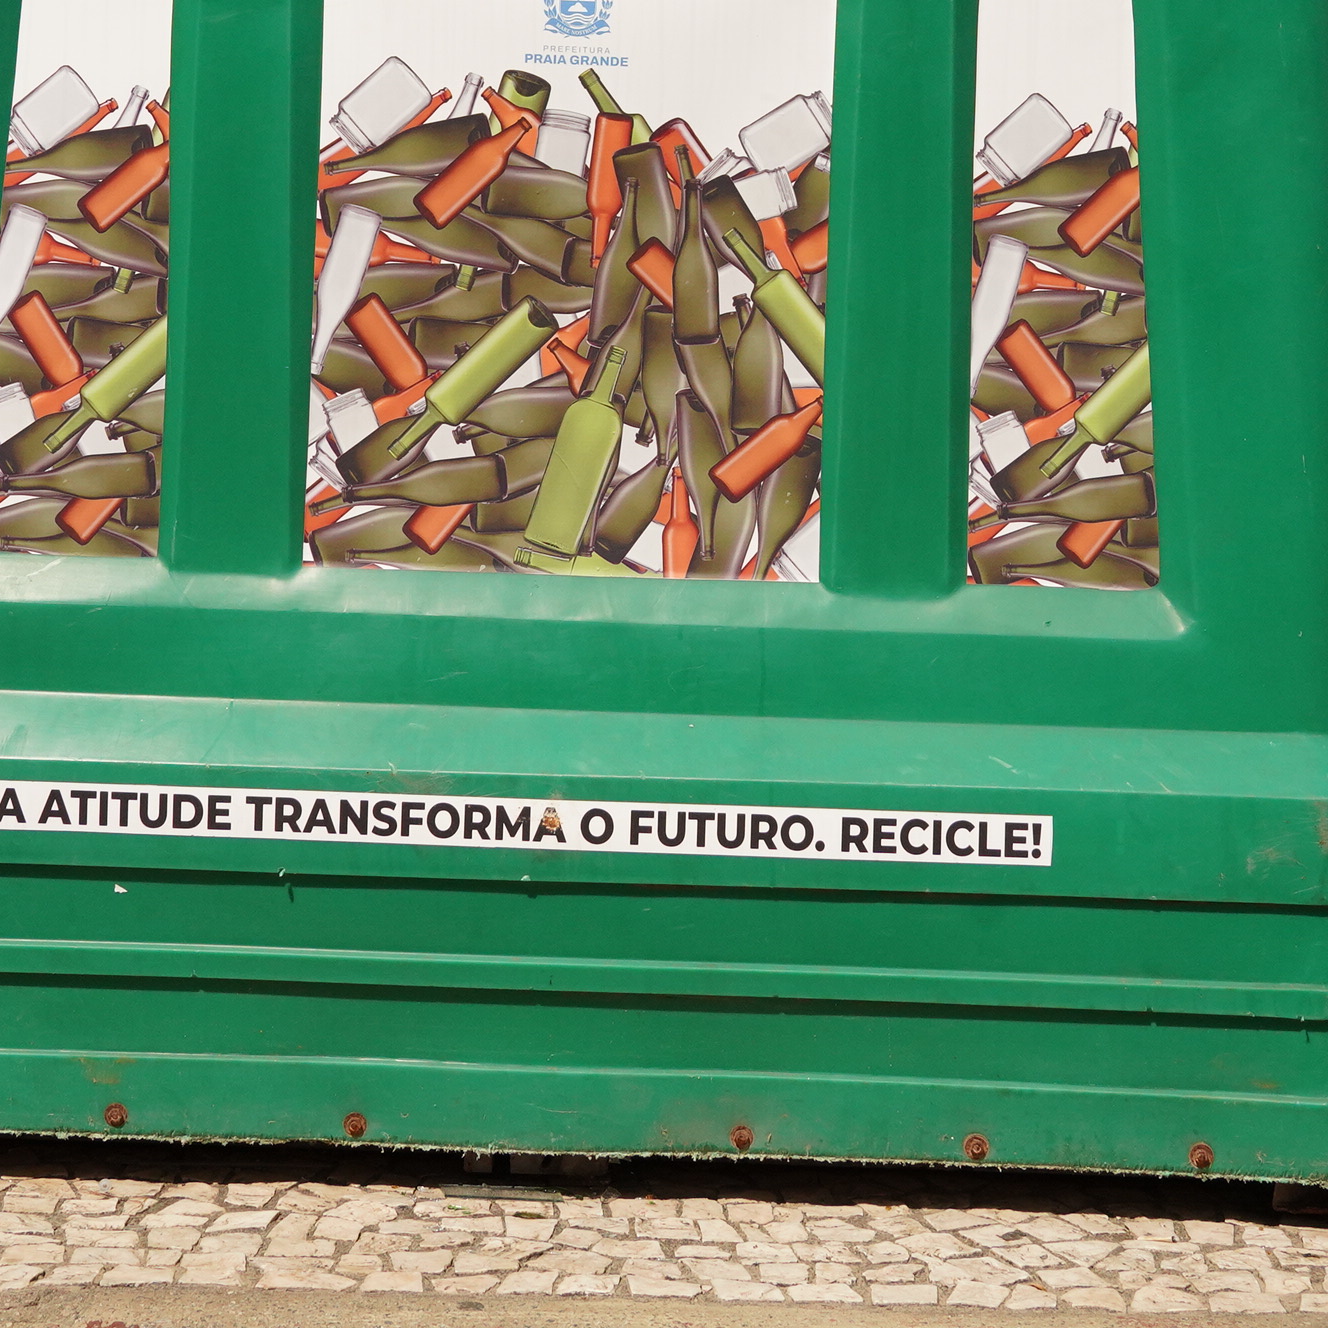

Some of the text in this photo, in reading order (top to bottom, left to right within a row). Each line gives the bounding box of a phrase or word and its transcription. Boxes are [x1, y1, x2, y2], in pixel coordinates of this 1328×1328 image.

[543, 45, 610, 53] PREFEITURA
[526, 55, 628, 67] PRAIA GRANDE
[40, 791, 232, 831] ATITUDE
[247, 798, 566, 843] TRANSFORMA
[582, 810, 614, 845] O
[631, 812, 825, 852] FUTURO.
[843, 819, 1042, 859] RECICLE!
